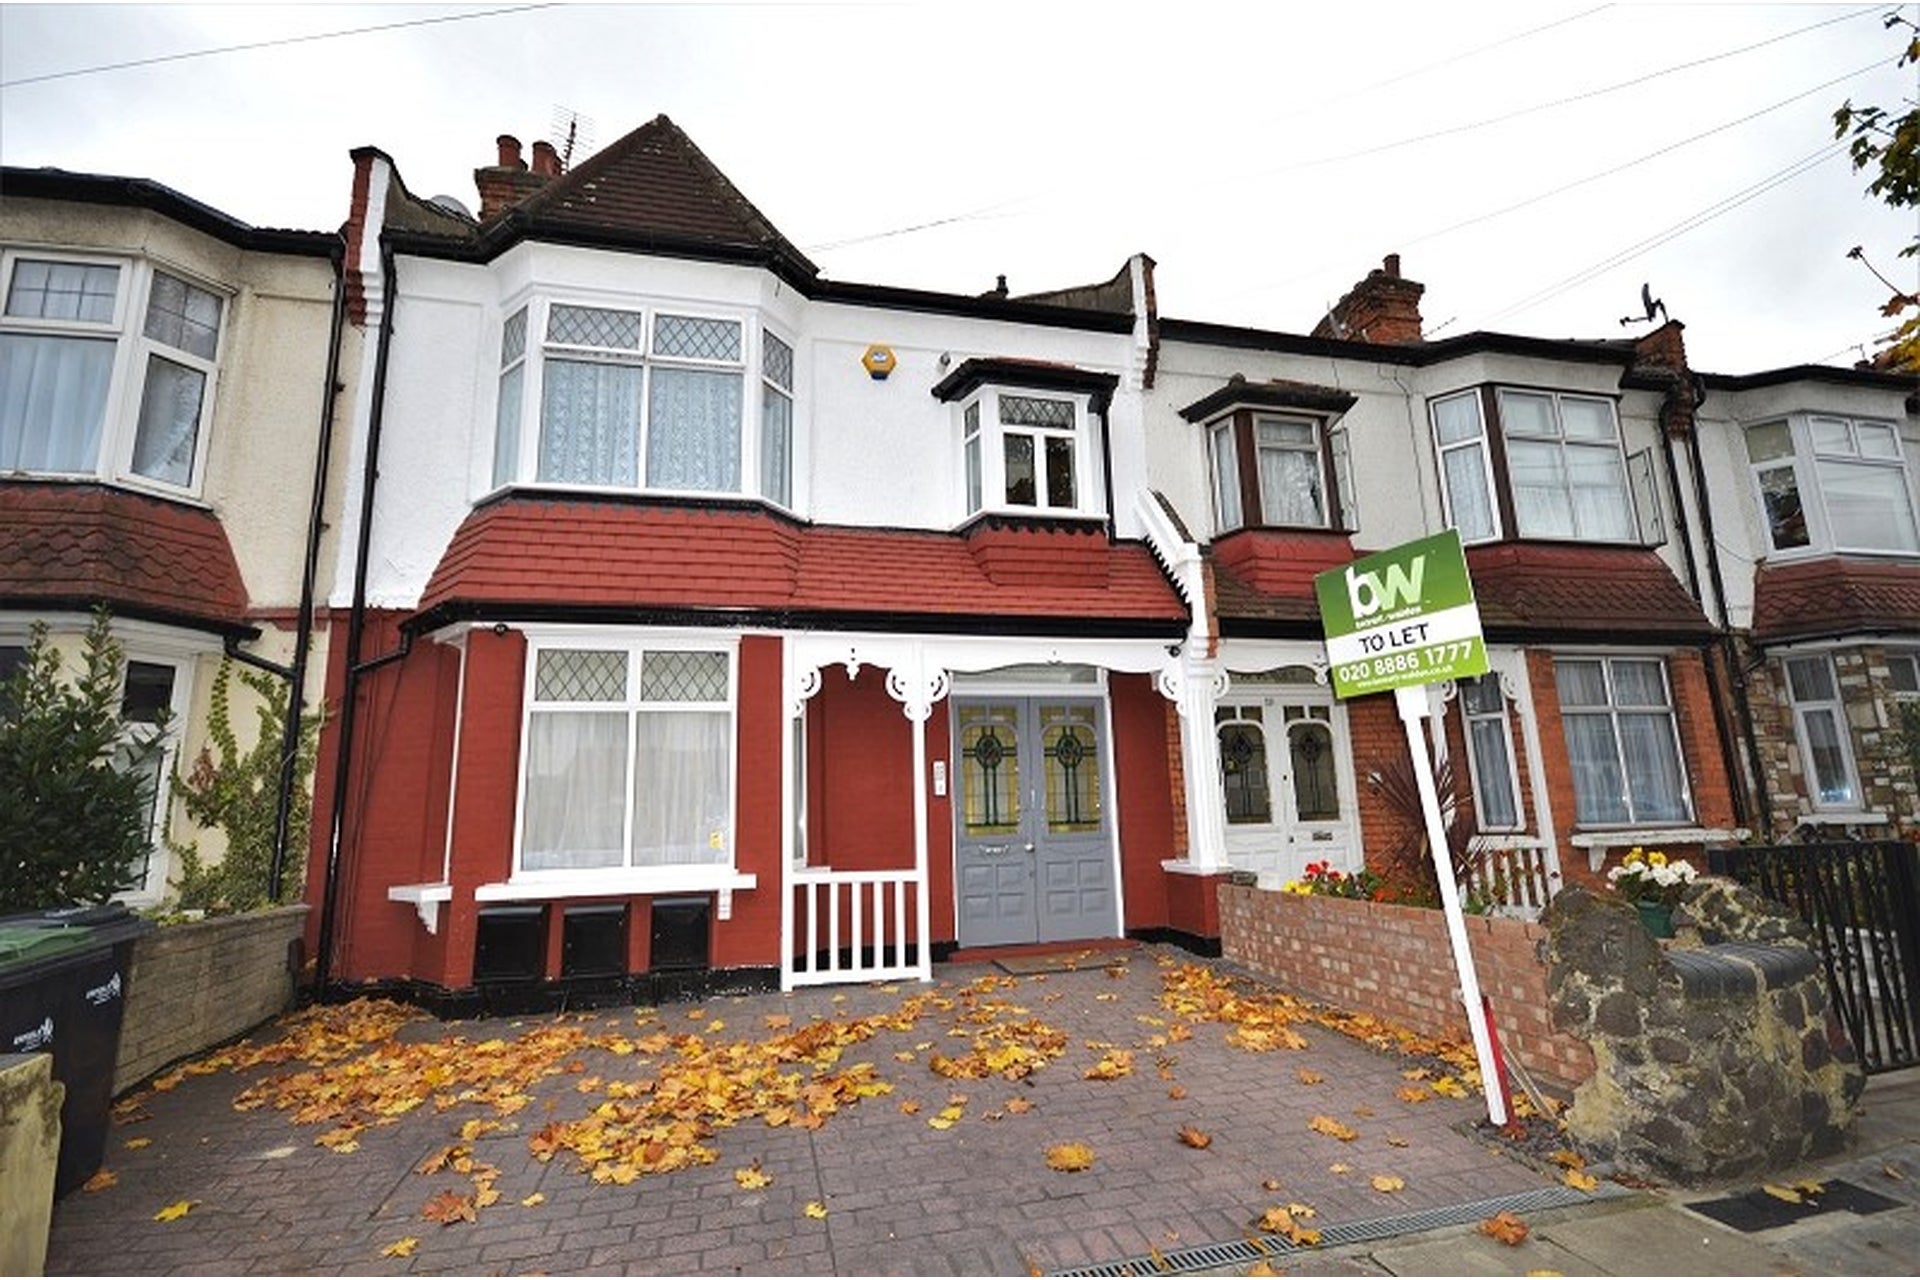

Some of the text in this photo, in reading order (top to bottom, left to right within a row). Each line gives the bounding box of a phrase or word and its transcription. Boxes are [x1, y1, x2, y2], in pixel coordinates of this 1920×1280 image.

[1358, 623, 1430, 654] TO LET
[1339, 662, 1370, 683] 020
[1374, 652, 1420, 676] 8886
[1425, 640, 1473, 667] 1777
